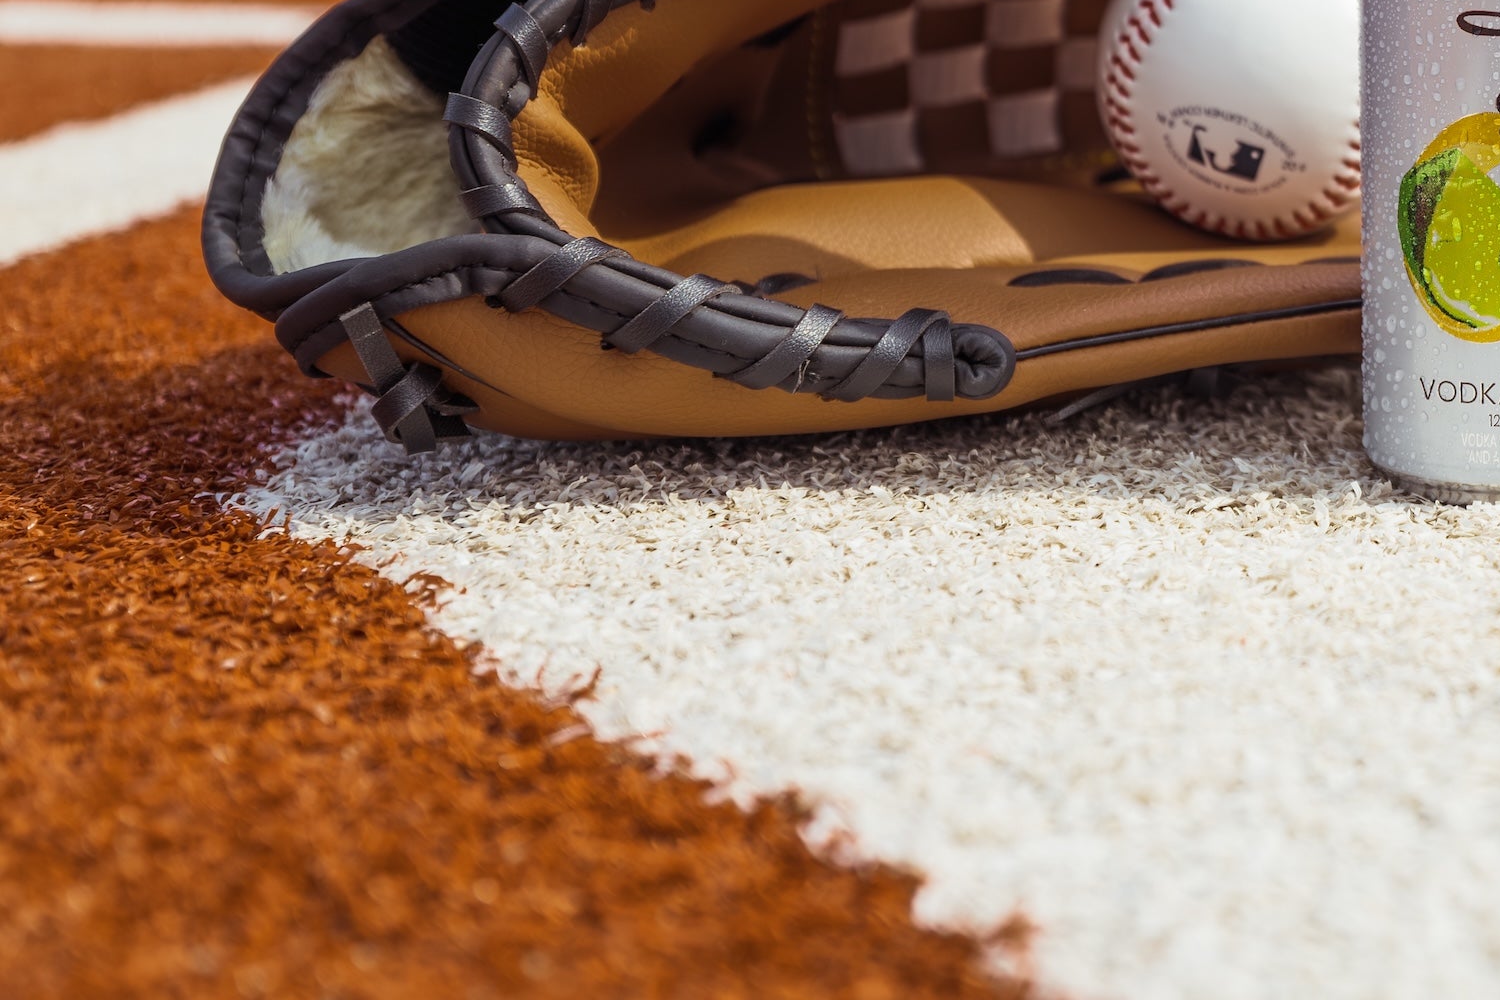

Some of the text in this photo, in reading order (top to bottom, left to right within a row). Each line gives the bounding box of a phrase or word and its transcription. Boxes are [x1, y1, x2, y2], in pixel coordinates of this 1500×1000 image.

[1488, 413, 1500, 428] 12
[1460, 432, 1498, 448] VODKA
[1468, 449, 1491, 465] AND
